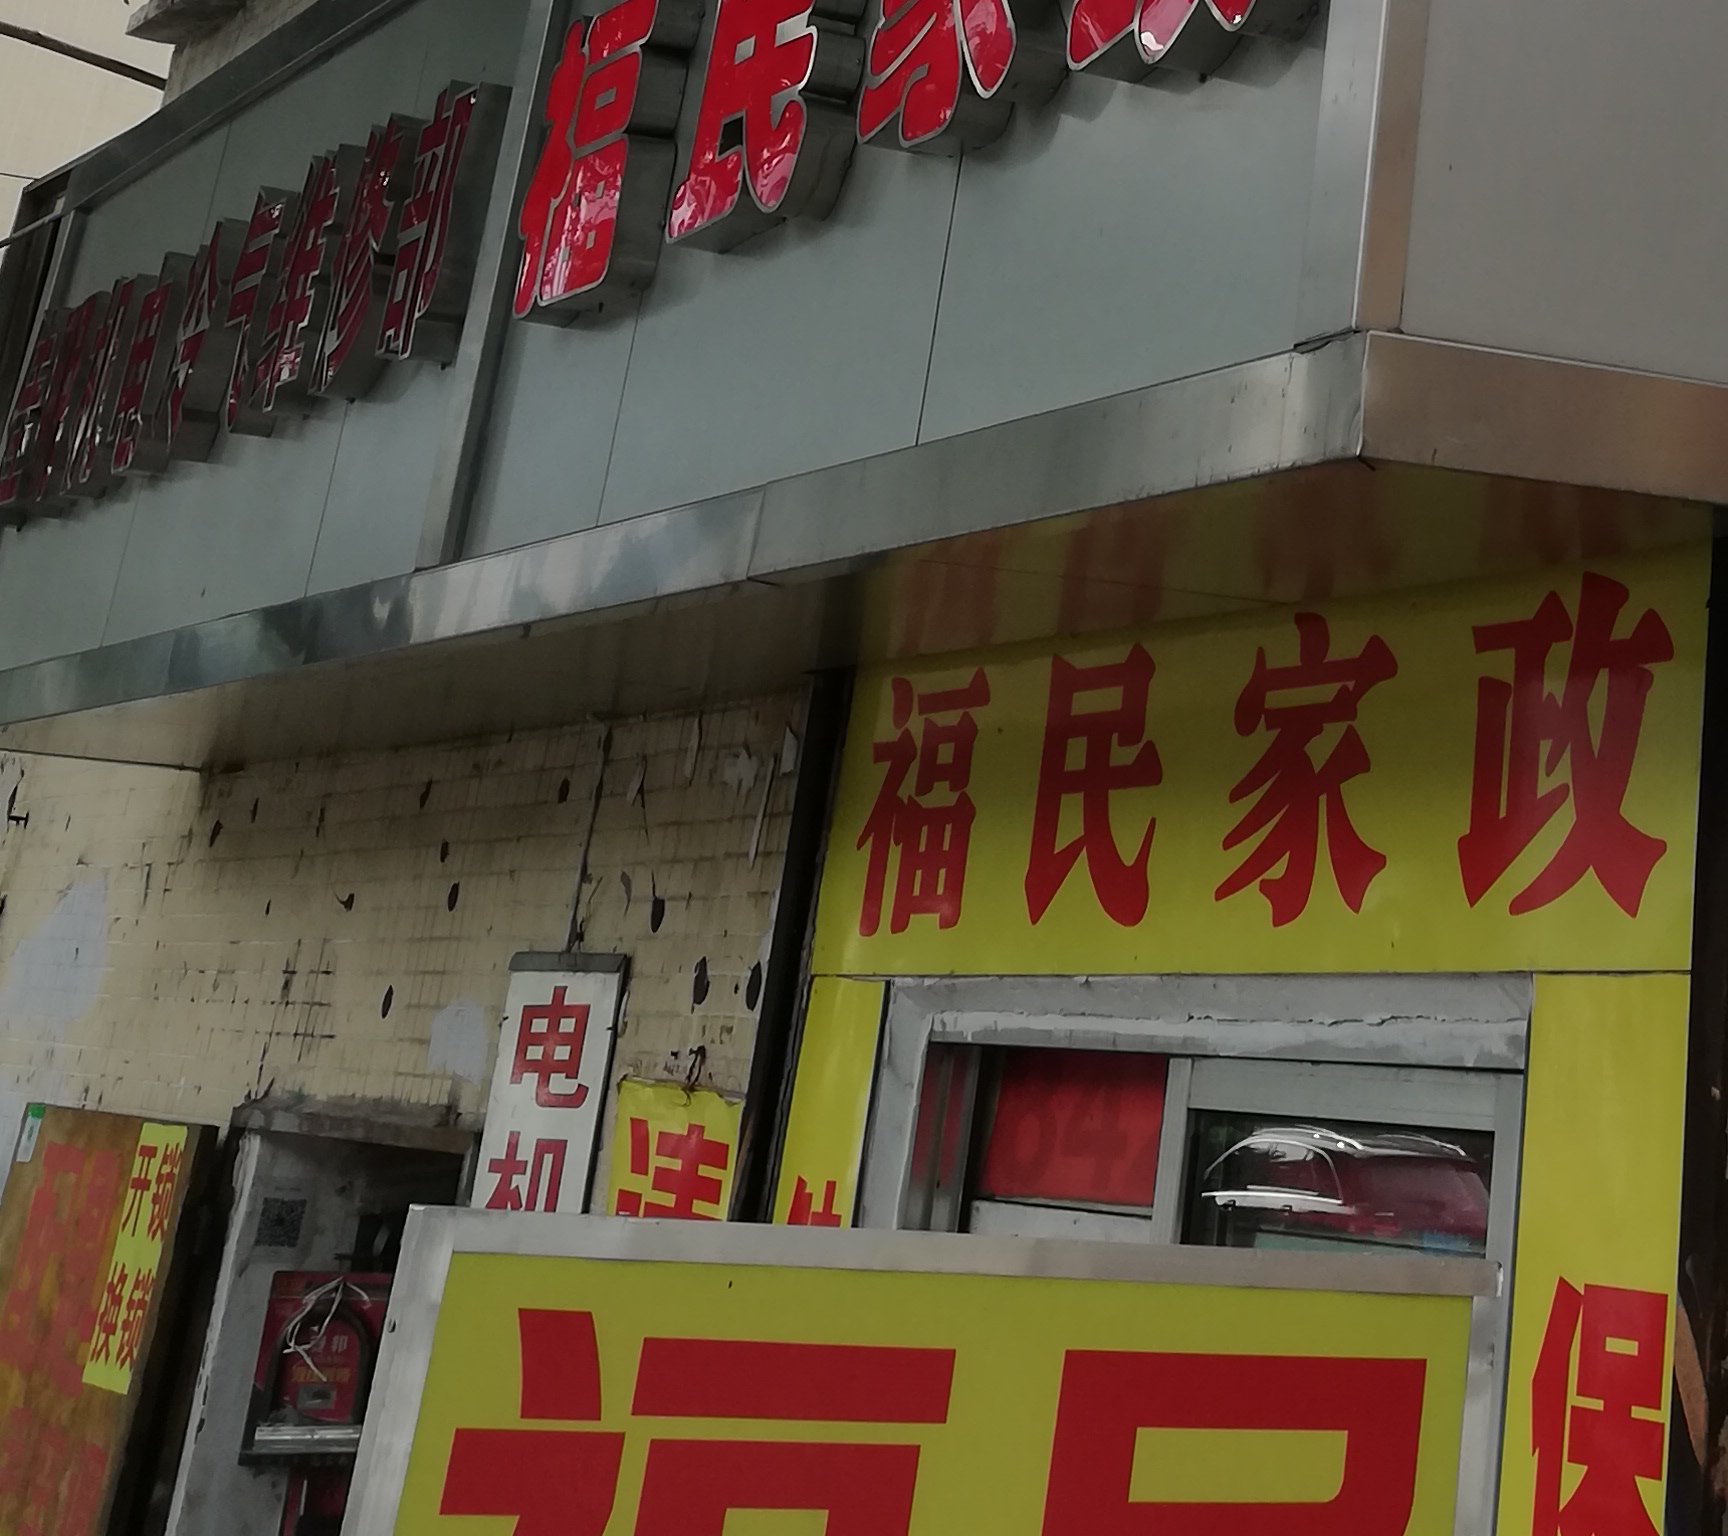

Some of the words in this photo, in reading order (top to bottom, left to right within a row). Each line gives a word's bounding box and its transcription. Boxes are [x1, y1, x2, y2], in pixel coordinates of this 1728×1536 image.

[856, 571, 1675, 938] 福民家政
[121, 1141, 184, 1242] 开锁
[89, 1260, 156, 1372] 换锁
